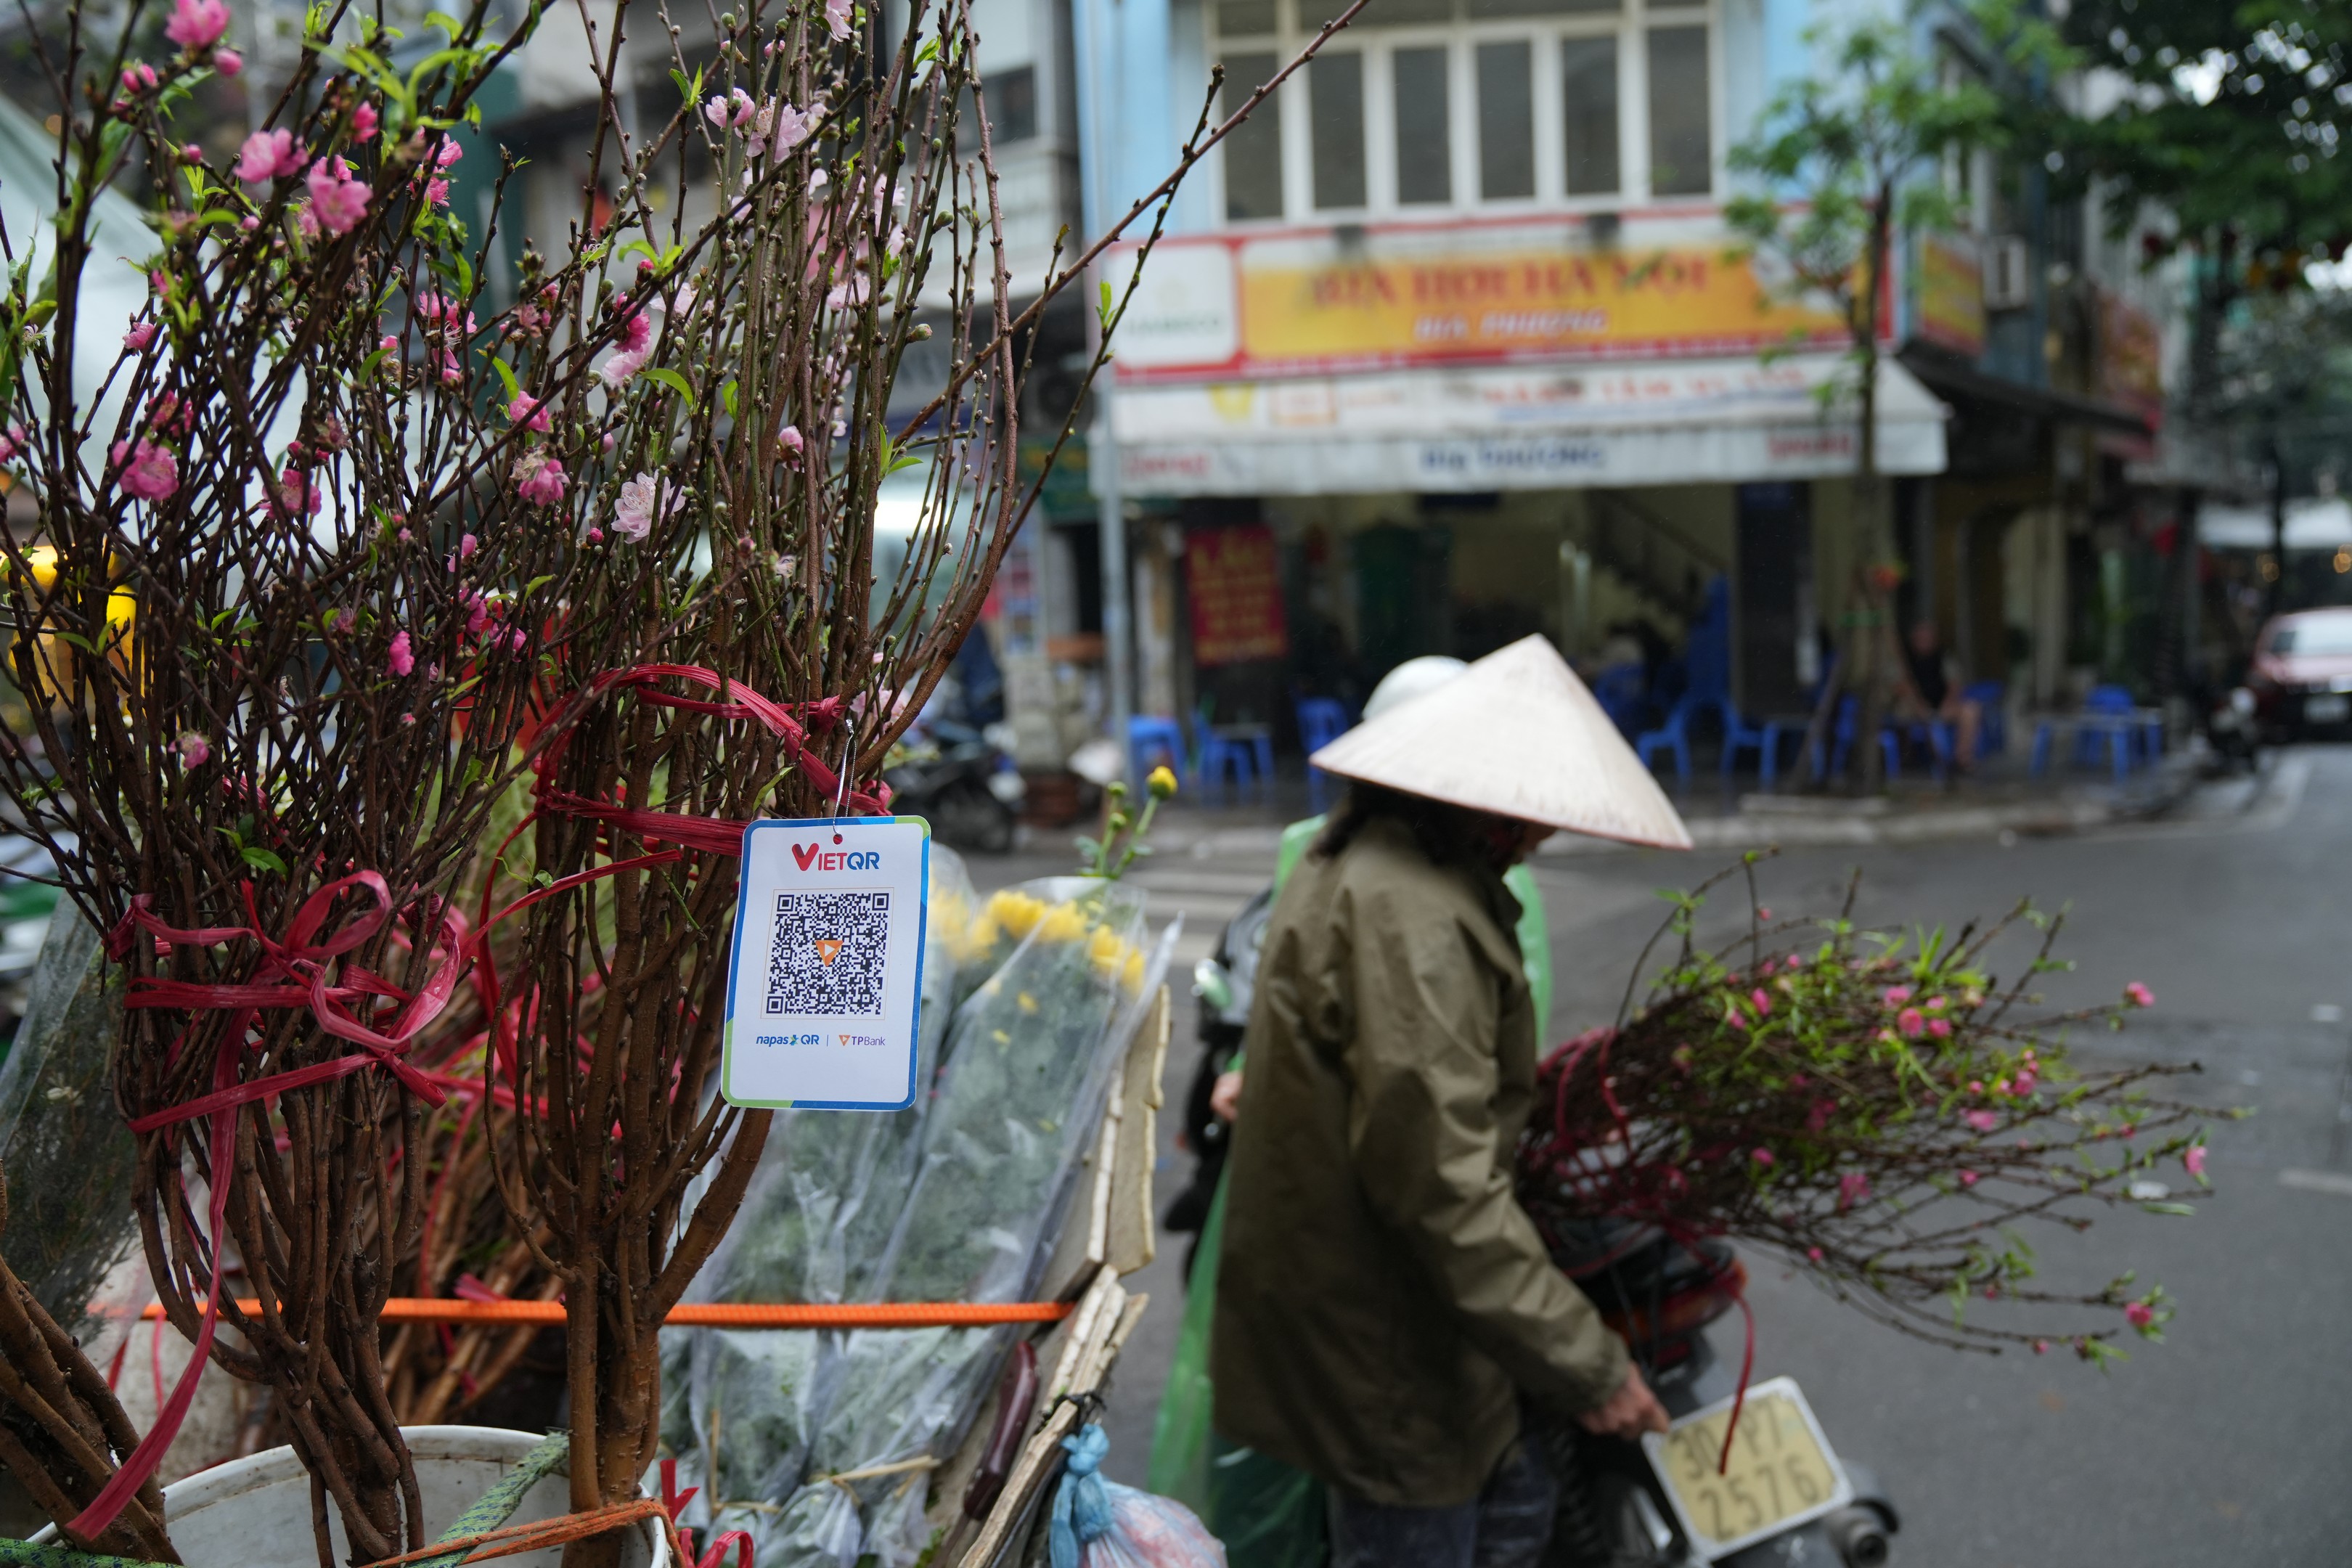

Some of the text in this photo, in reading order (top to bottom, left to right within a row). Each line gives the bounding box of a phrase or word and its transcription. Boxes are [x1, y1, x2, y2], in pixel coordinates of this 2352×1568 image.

[791, 843, 880, 871] VIETQR
[756, 1034, 820, 1047] napas QR
[852, 1036, 886, 1046] TPBank
[1696, 1452, 1820, 1543] 2576
